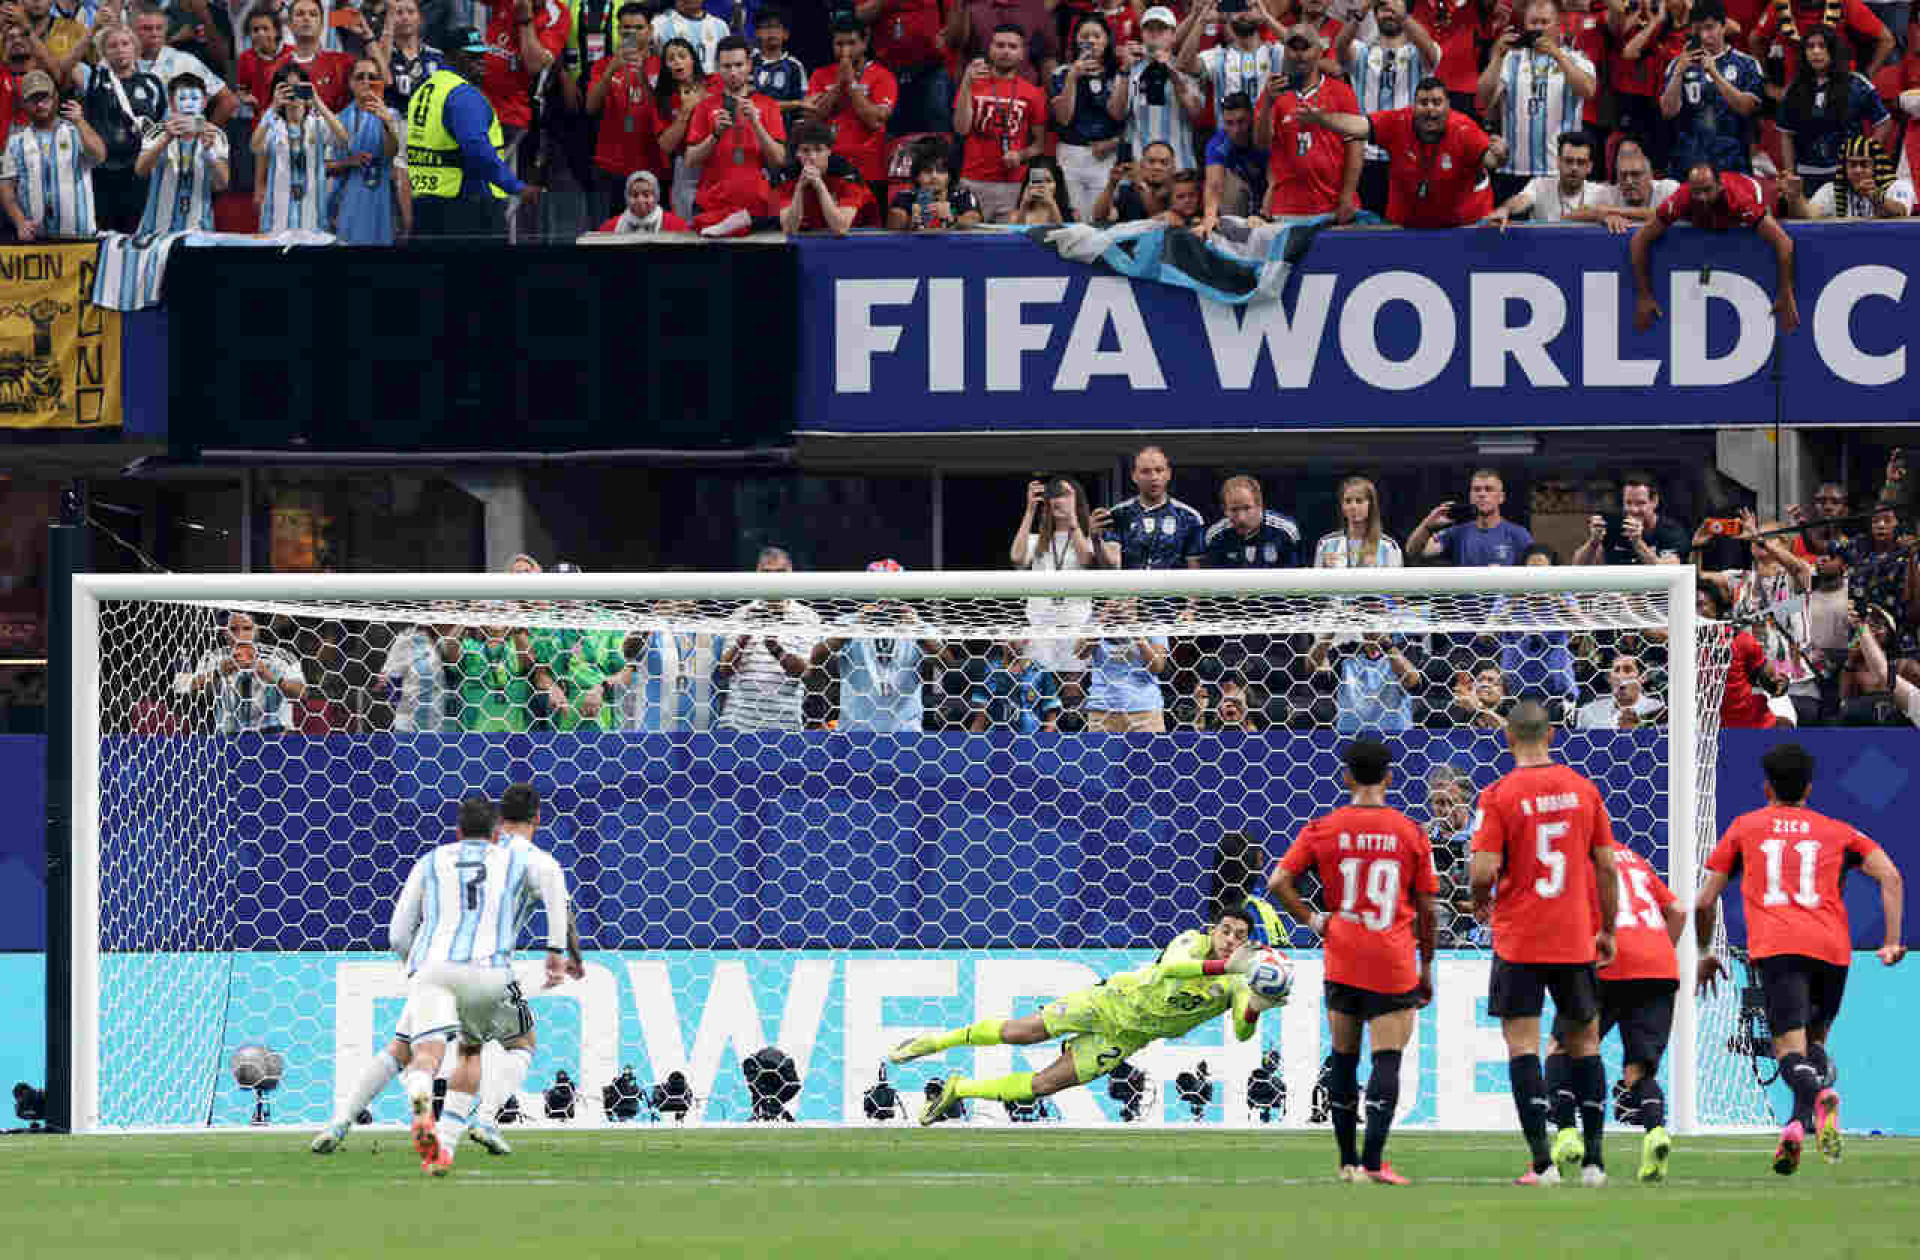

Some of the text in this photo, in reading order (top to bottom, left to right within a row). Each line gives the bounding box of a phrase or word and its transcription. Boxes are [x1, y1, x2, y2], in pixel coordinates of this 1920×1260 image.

[834, 264, 1908, 394] FIFA WORLD C
[456, 860, 487, 911] 7
[1338, 857, 1401, 931] 19
[1535, 820, 1571, 899] 5
[1760, 839, 1823, 909] 11
[1615, 866, 1665, 929] 15
